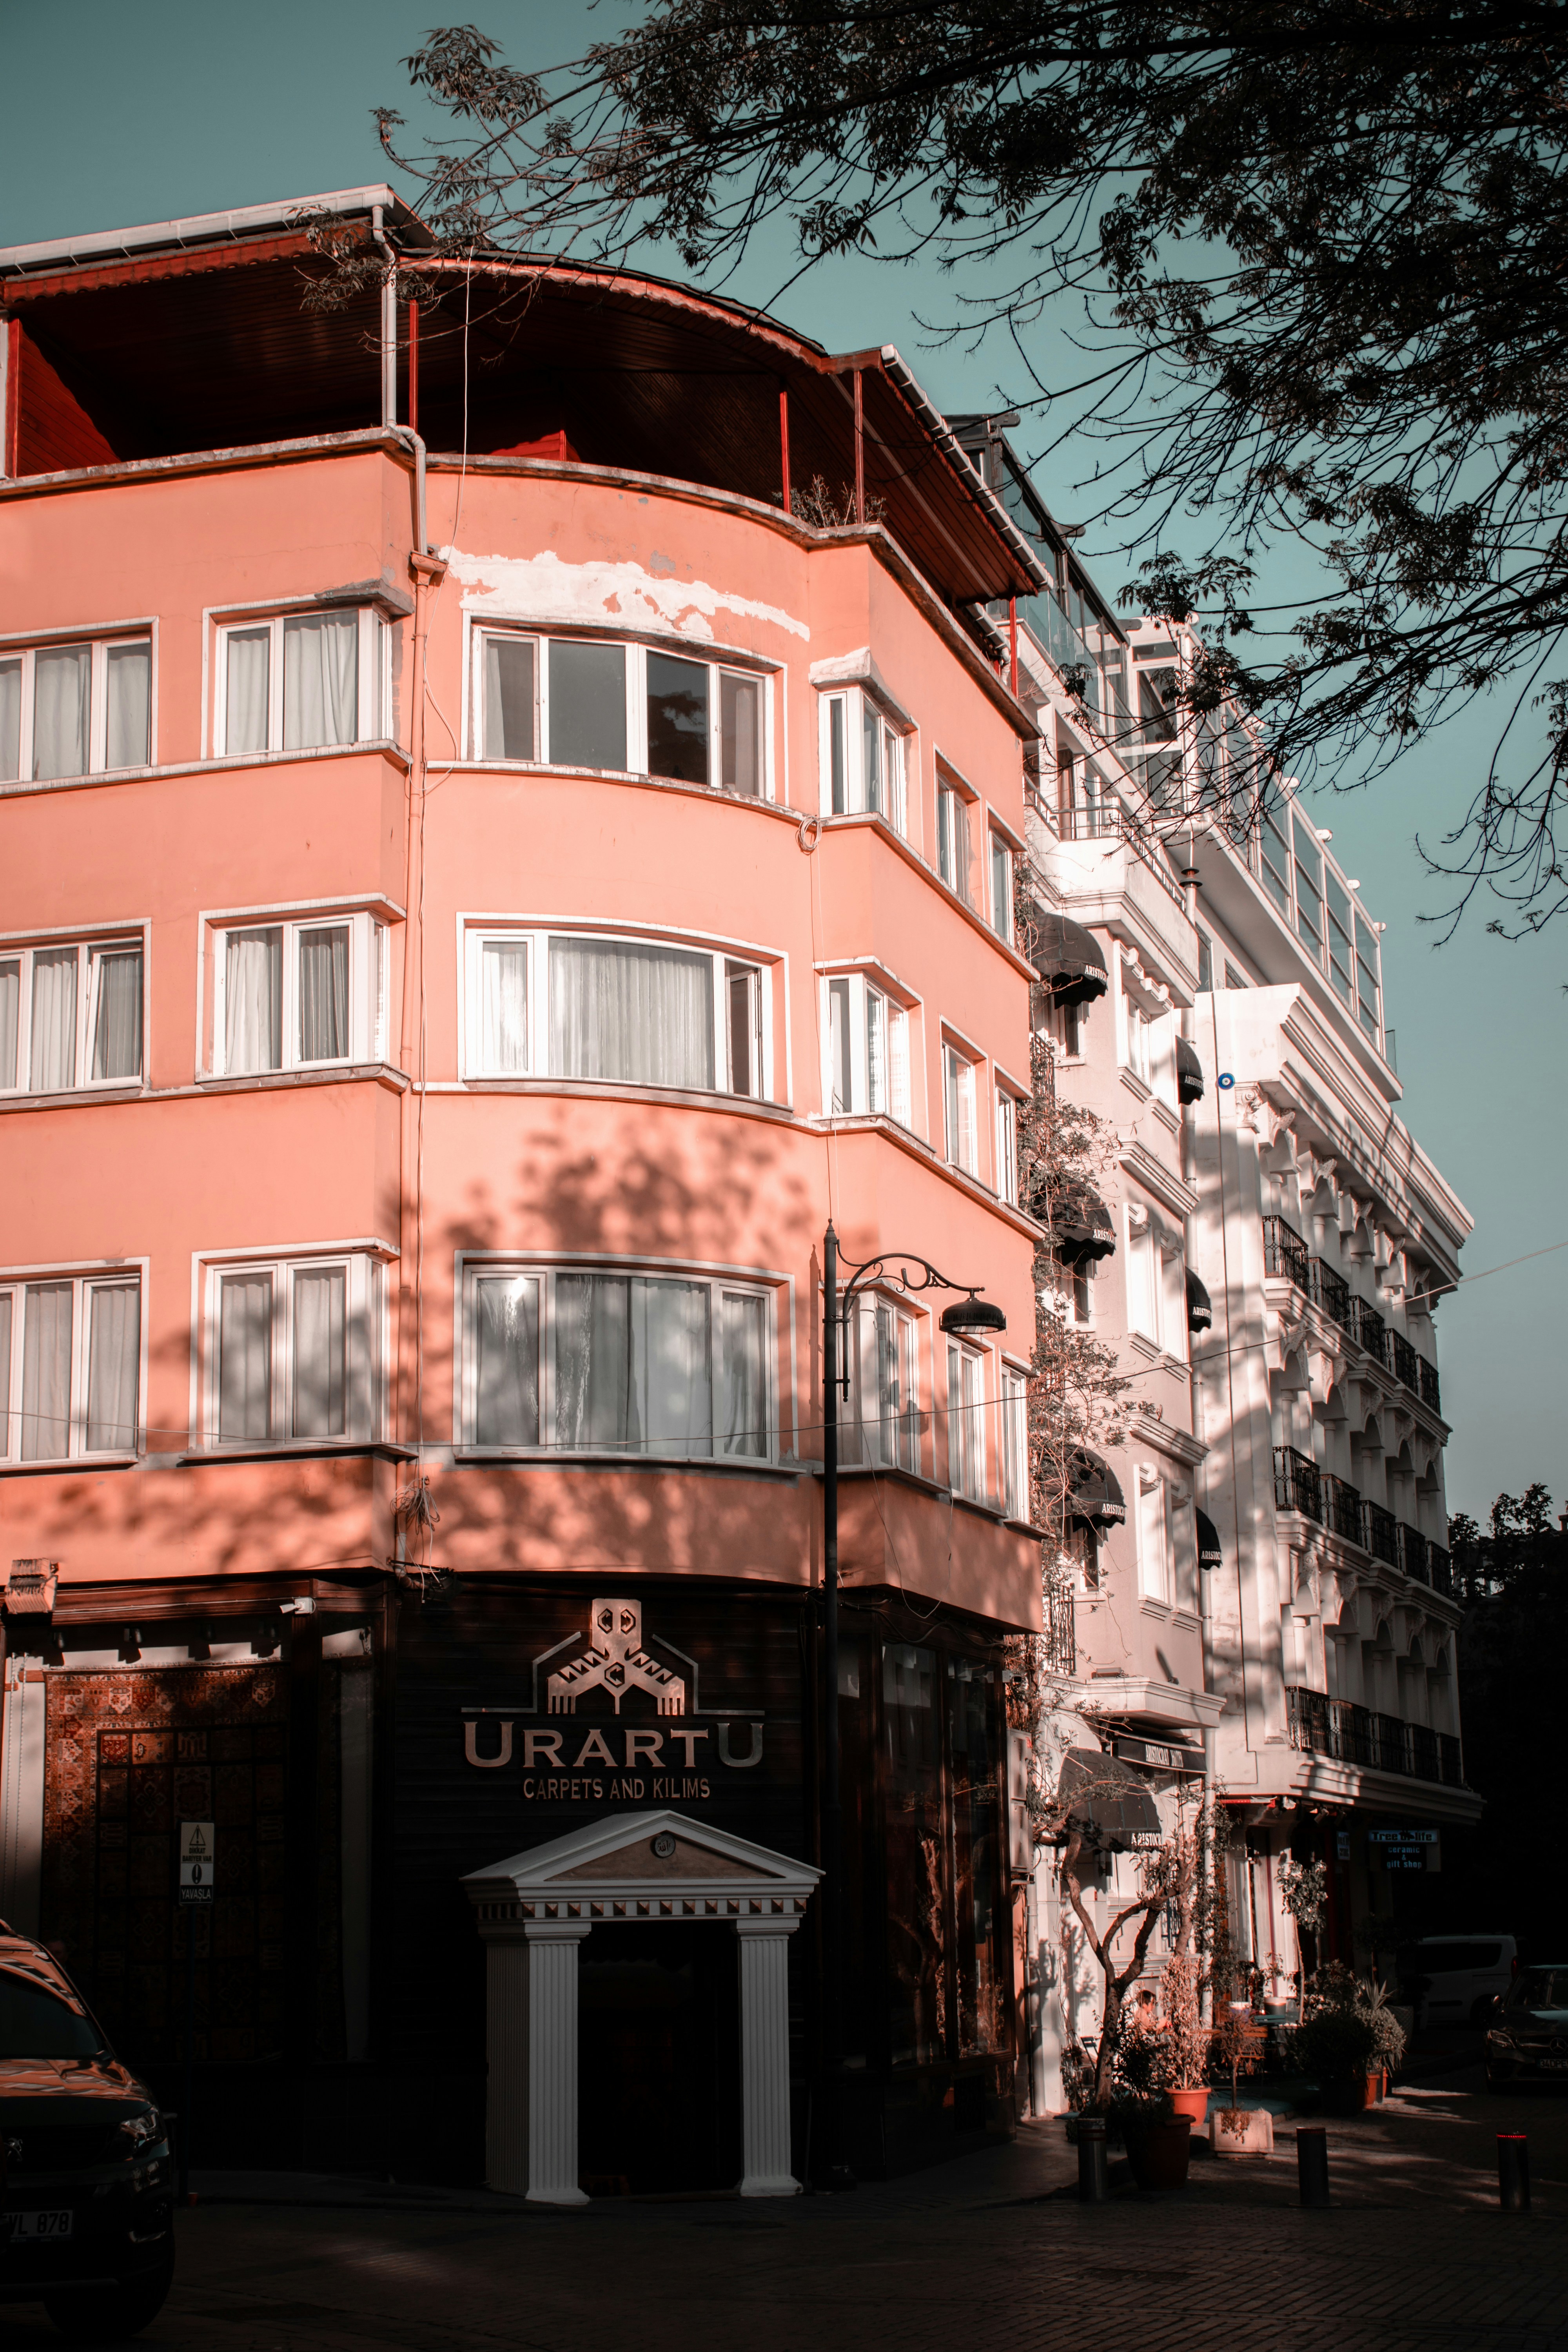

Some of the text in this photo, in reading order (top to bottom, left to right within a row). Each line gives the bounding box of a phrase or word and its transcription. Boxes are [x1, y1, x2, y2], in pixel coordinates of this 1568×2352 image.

[1192, 1306, 1210, 1318] ARISTOC
[463, 1722, 764, 1768] URARTU
[1145, 1744, 1183, 1768] ARISTOCRAT HOTEL
[523, 1778, 710, 1800] CARPETS AND KILIMS
[1372, 1831, 1398, 1840] Tree
[1415, 1831, 1432, 1841] life
[1388, 1846, 1420, 1854] ceramic
[1387, 1860, 1422, 1869] gift shop
[181, 1889, 211, 1902] YAVAŞLA
[37, 2212, 69, 2234] 878
